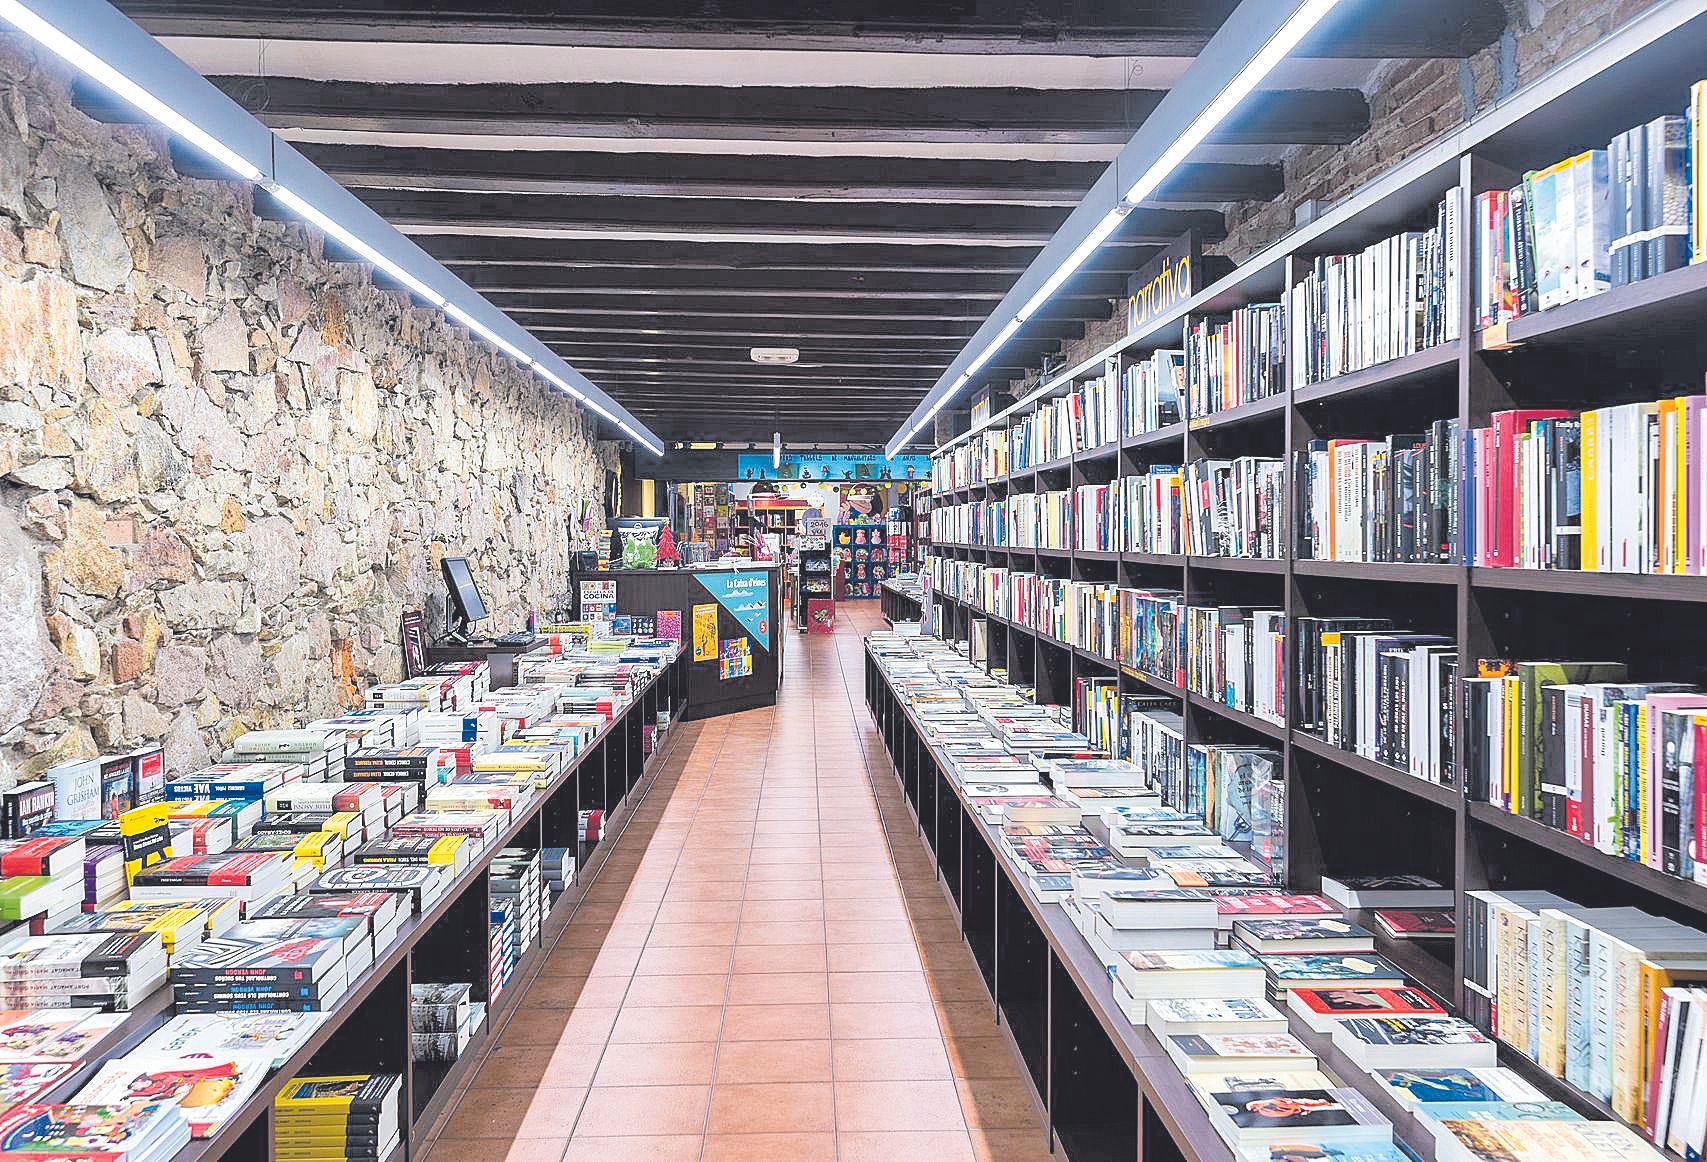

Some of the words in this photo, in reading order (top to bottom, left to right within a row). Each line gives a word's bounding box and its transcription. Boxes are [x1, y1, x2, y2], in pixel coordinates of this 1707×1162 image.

[1129, 256, 1190, 328] narrativa
[726, 579, 733, 588] La
[74, 772, 95, 791] JOHN
[194, 784, 210, 794] VAE
[67, 786, 99, 806] GRISHAM
[20, 799, 31, 817] IAN
